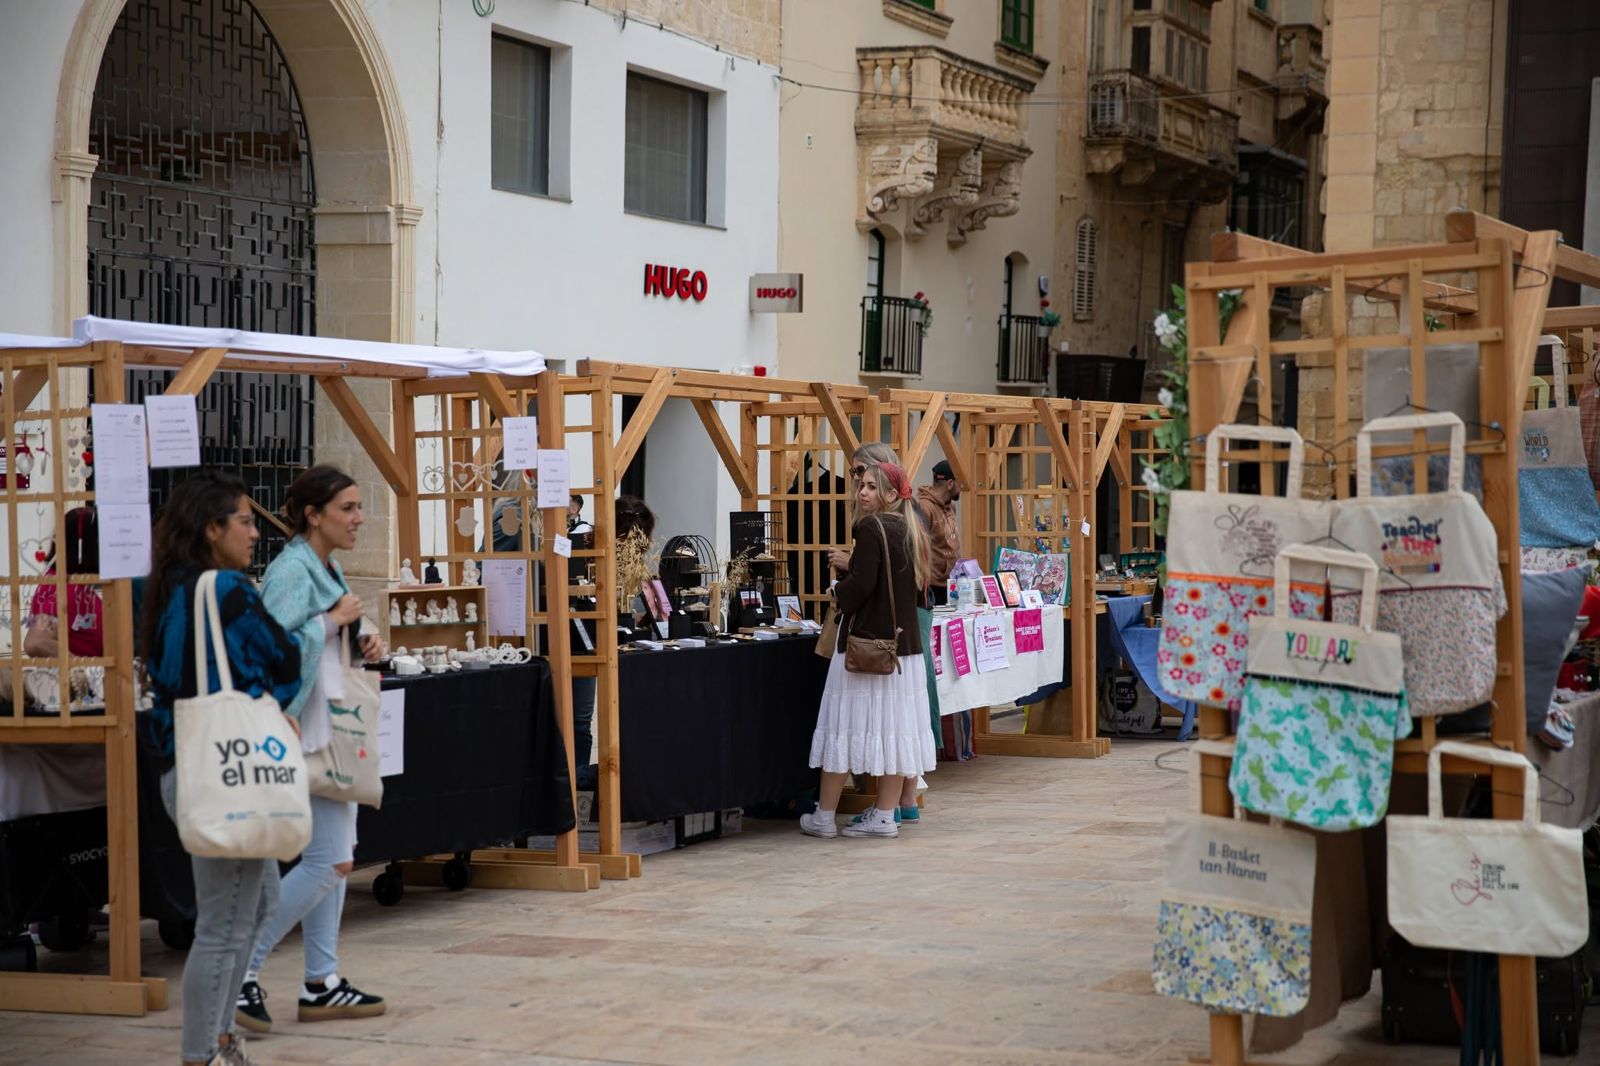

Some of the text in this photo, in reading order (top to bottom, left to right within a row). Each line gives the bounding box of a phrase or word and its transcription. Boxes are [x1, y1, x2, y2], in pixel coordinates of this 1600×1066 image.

[644, 263, 708, 302] HUGO
[756, 287, 797, 299] HUGO
[1523, 435, 1549, 447] WORLD
[1382, 516, 1444, 540] Teacher
[1286, 631, 1360, 661] YOU ARE
[215, 738, 250, 764] yo
[222, 761, 296, 787] el mar
[1199, 859, 1267, 882] tan-Nanna
